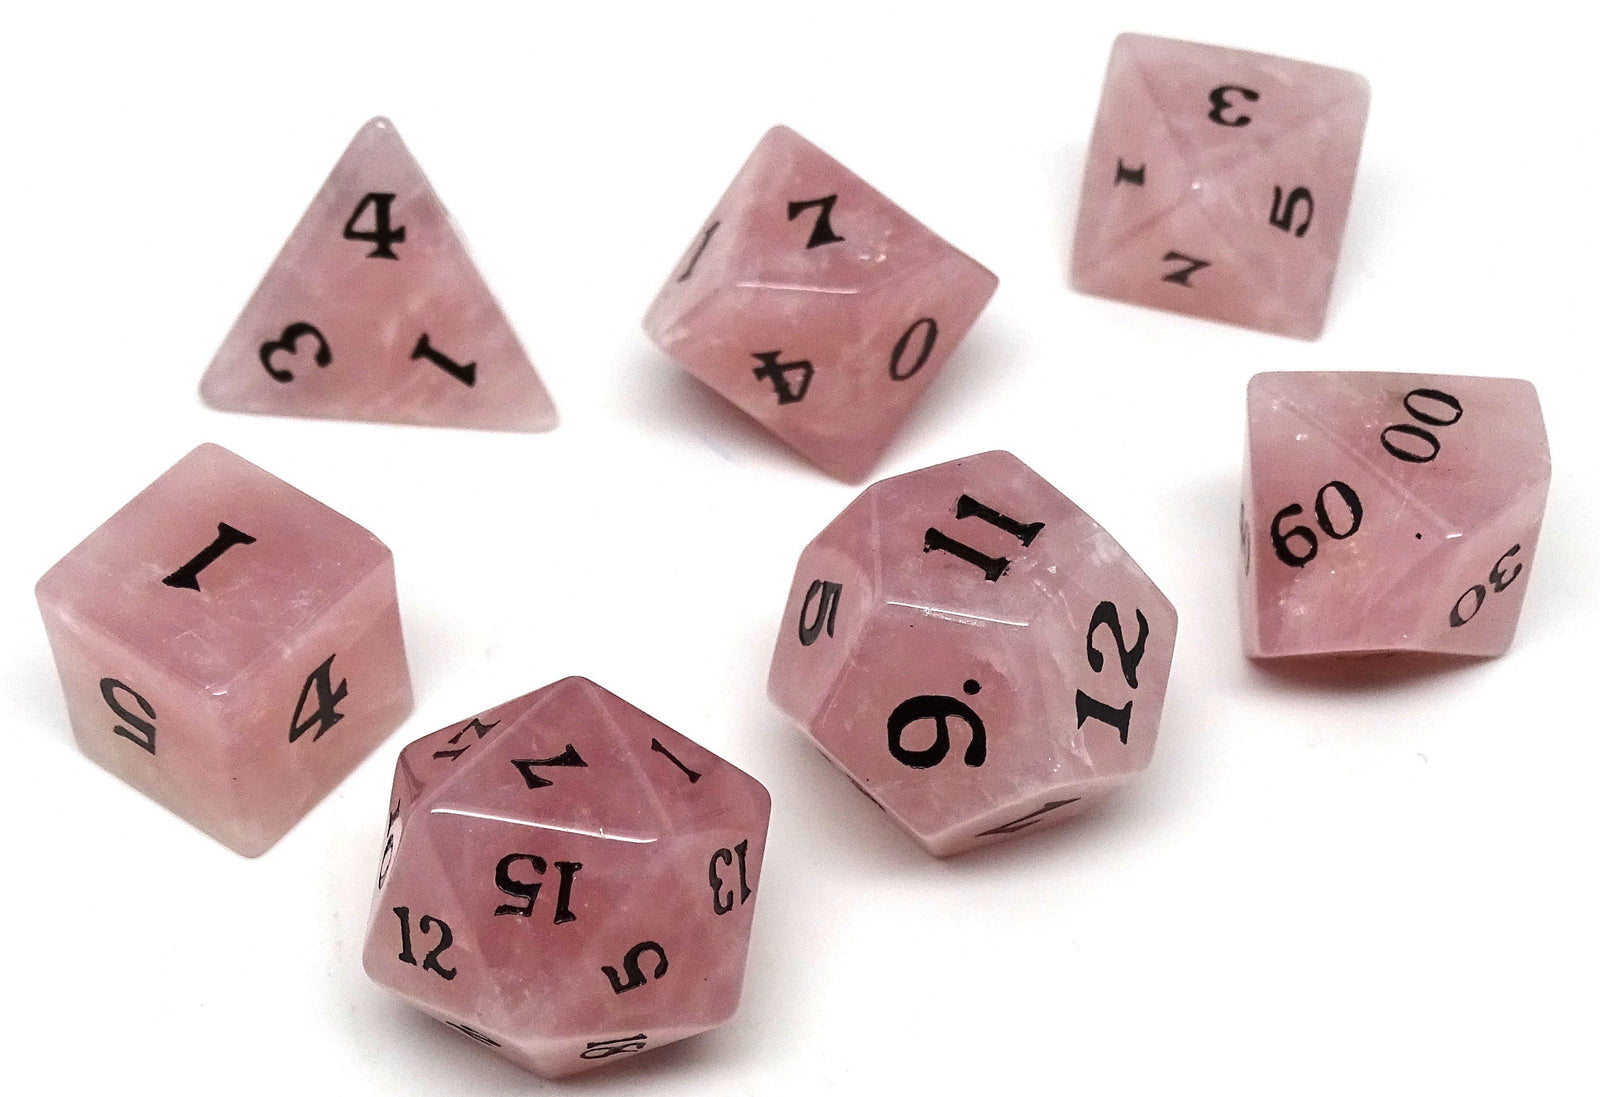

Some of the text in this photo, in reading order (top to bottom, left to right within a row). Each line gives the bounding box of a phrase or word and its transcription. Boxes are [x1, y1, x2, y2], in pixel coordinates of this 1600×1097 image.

[1208, 85, 1260, 128] 3
[1114, 158, 1146, 186] 1
[343, 192, 406, 261] 4
[787, 194, 846, 250] 7
[1269, 186, 1315, 238] 5
[677, 220, 721, 283] 1
[1161, 250, 1212, 288] 7
[259, 321, 333, 384] 3
[410, 332, 478, 388] 1
[750, 350, 815, 406] 4
[888, 317, 939, 382] 0
[1380, 388, 1465, 464] 00
[161, 521, 257, 593] 1
[923, 494, 1046, 584] 11
[798, 579, 844, 647] 5
[1449, 543, 1524, 628] 30
[288, 653, 349, 744] 4
[1072, 600, 1150, 746] 12
[99, 677, 158, 756] 5
[510, 743, 589, 790] 7
[650, 737, 703, 785] 1
[493, 852, 584, 926] 15
[708, 838, 753, 917] 13
[392, 905, 459, 982] 12
[600, 940, 670, 996] 5
